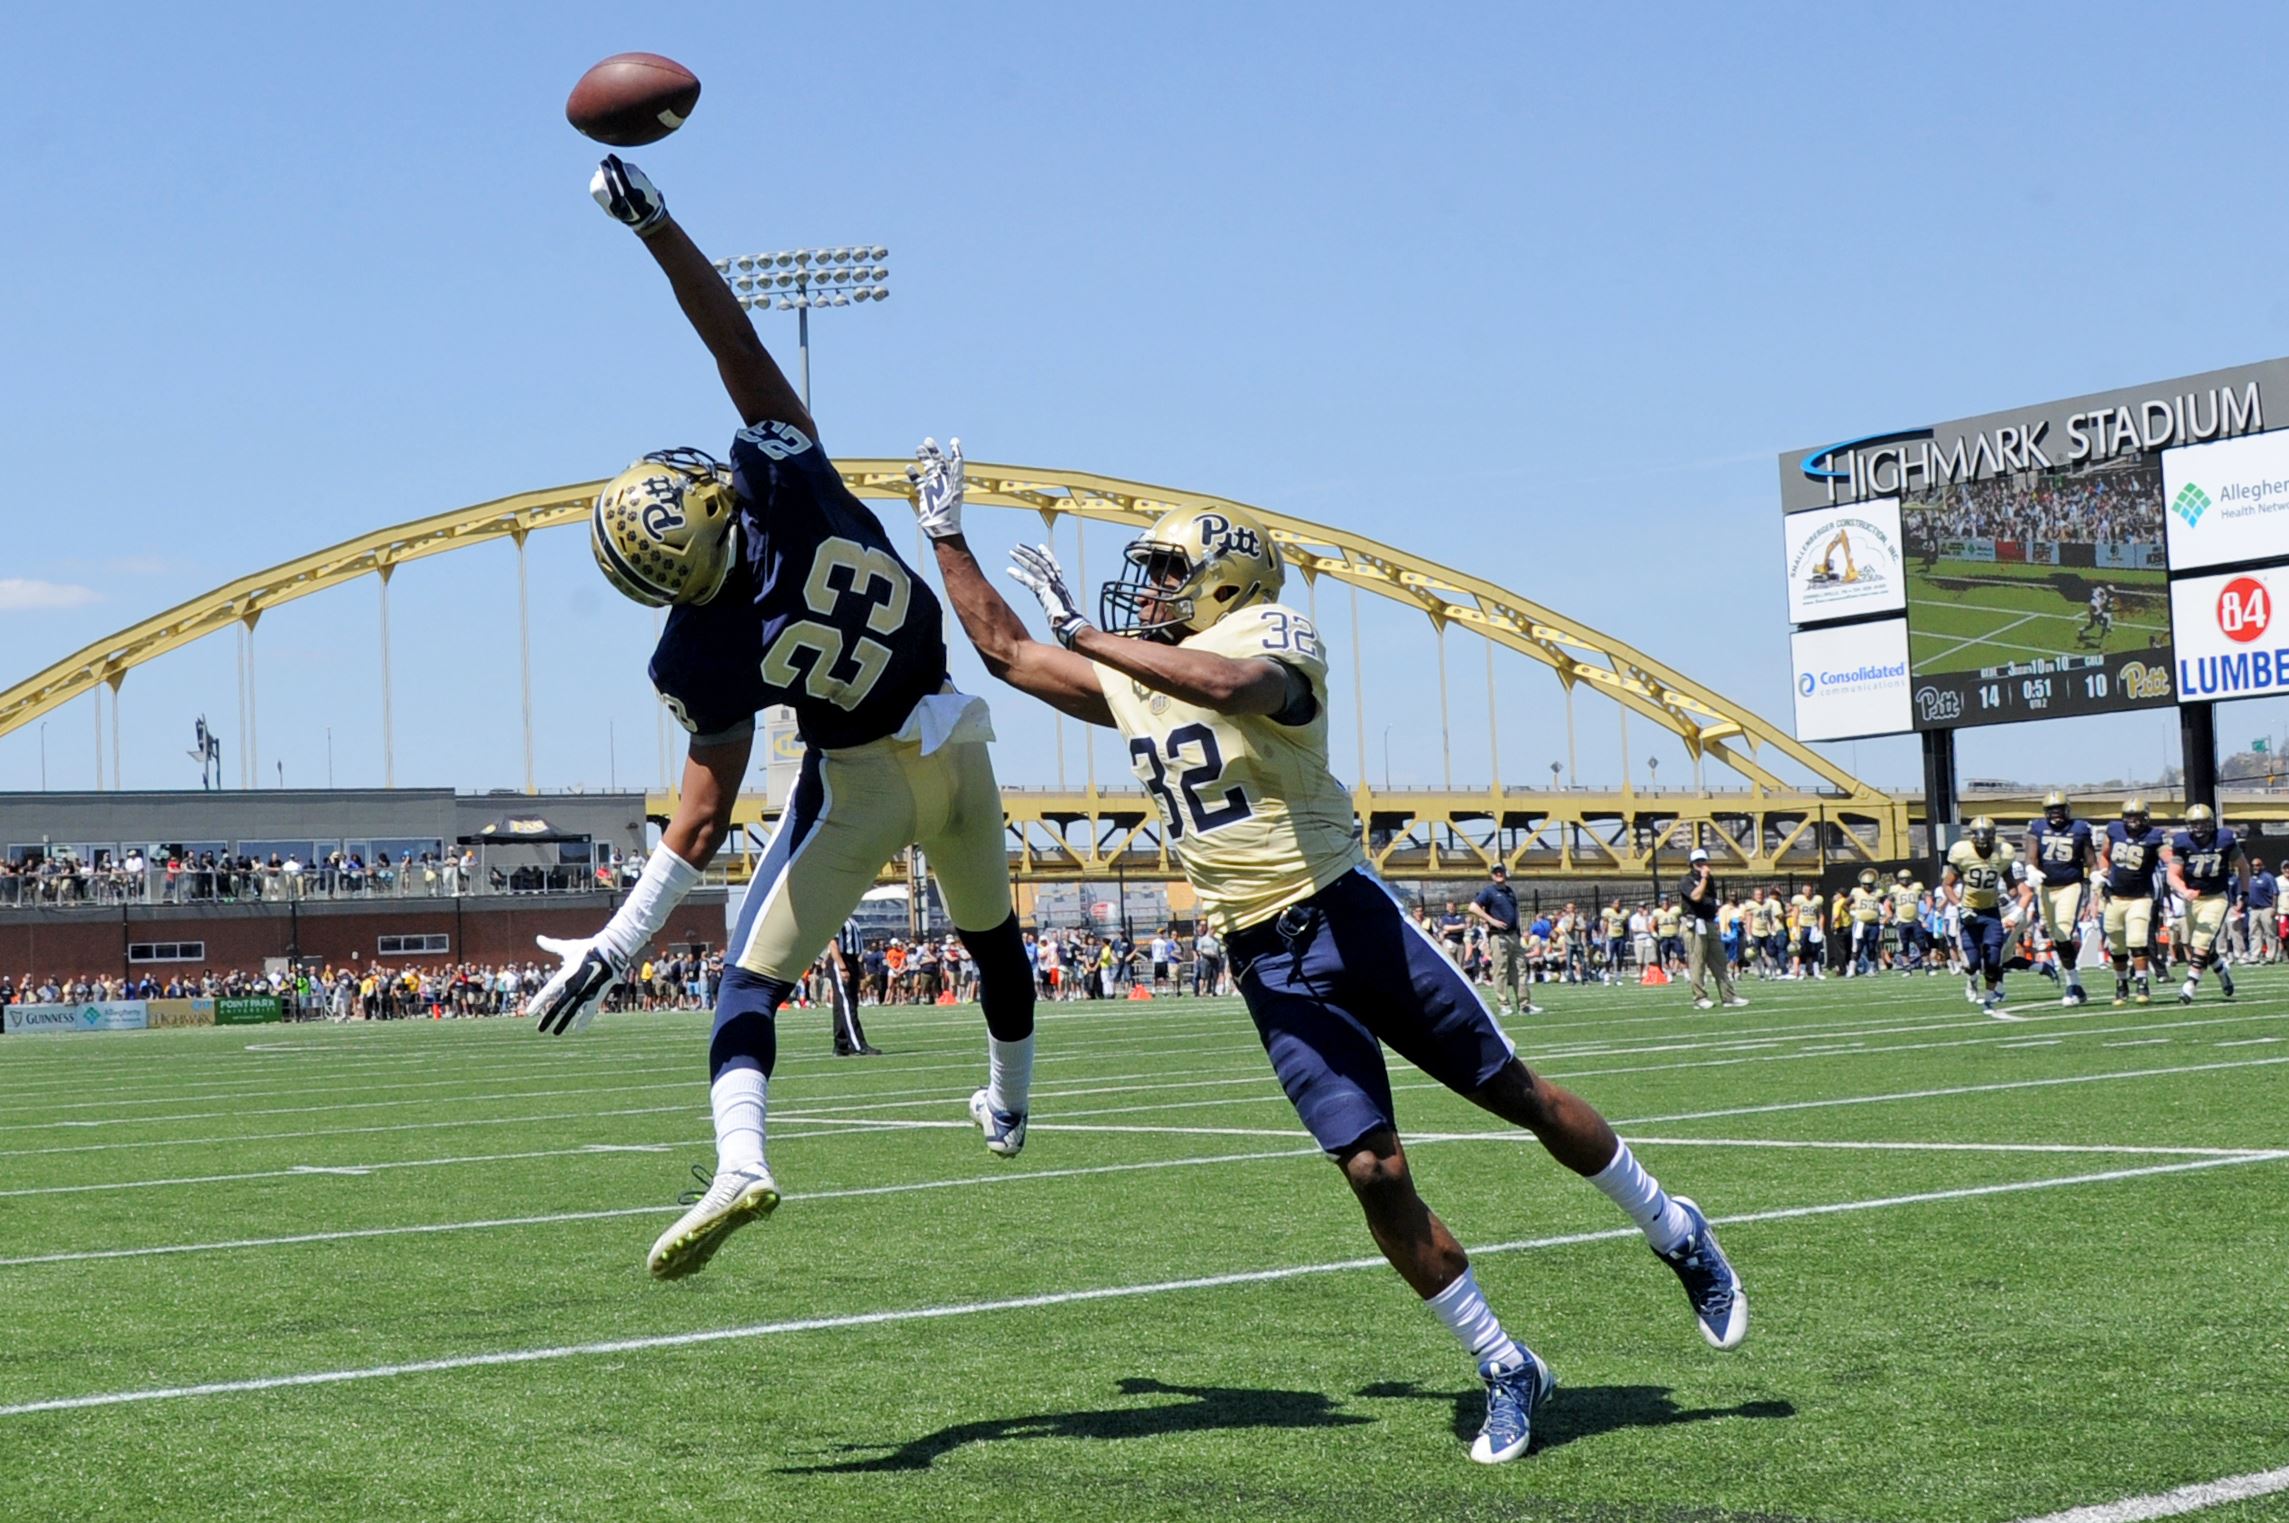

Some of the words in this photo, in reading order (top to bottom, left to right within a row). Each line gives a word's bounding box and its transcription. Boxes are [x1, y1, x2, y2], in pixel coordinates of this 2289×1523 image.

[1825, 420, 2052, 501] HIGHMARK
[2065, 381, 2263, 460] STADIUM
[640, 474, 686, 541] Pitt
[2221, 503, 2256, 519] Health
[1192, 513, 1261, 558] Pitt
[2222, 588, 2267, 632] 84
[760, 536, 911, 712] 23
[1259, 610, 1319, 657] 32
[1820, 662, 1905, 685] Consolidated
[2054, 655, 2069, 671] 10
[2180, 648, 2289, 696] LUMBE
[1820, 680, 1905, 696] communications
[2023, 678, 2052, 699] 0:51
[2085, 673, 2107, 698] 10
[2120, 661, 2171, 699] Pitt
[1915, 686, 1961, 721] Pitt
[1979, 685, 2000, 709] 14
[1129, 722, 1253, 841] 32
[2041, 835, 2075, 862] 75
[2110, 841, 2144, 871] 66
[1968, 868, 1999, 890] 92
[2188, 853, 2222, 878] 77
[220, 999, 249, 1009] POINT
[249, 998, 276, 1007] PARK
[26, 1012, 76, 1026] GUINNESS
